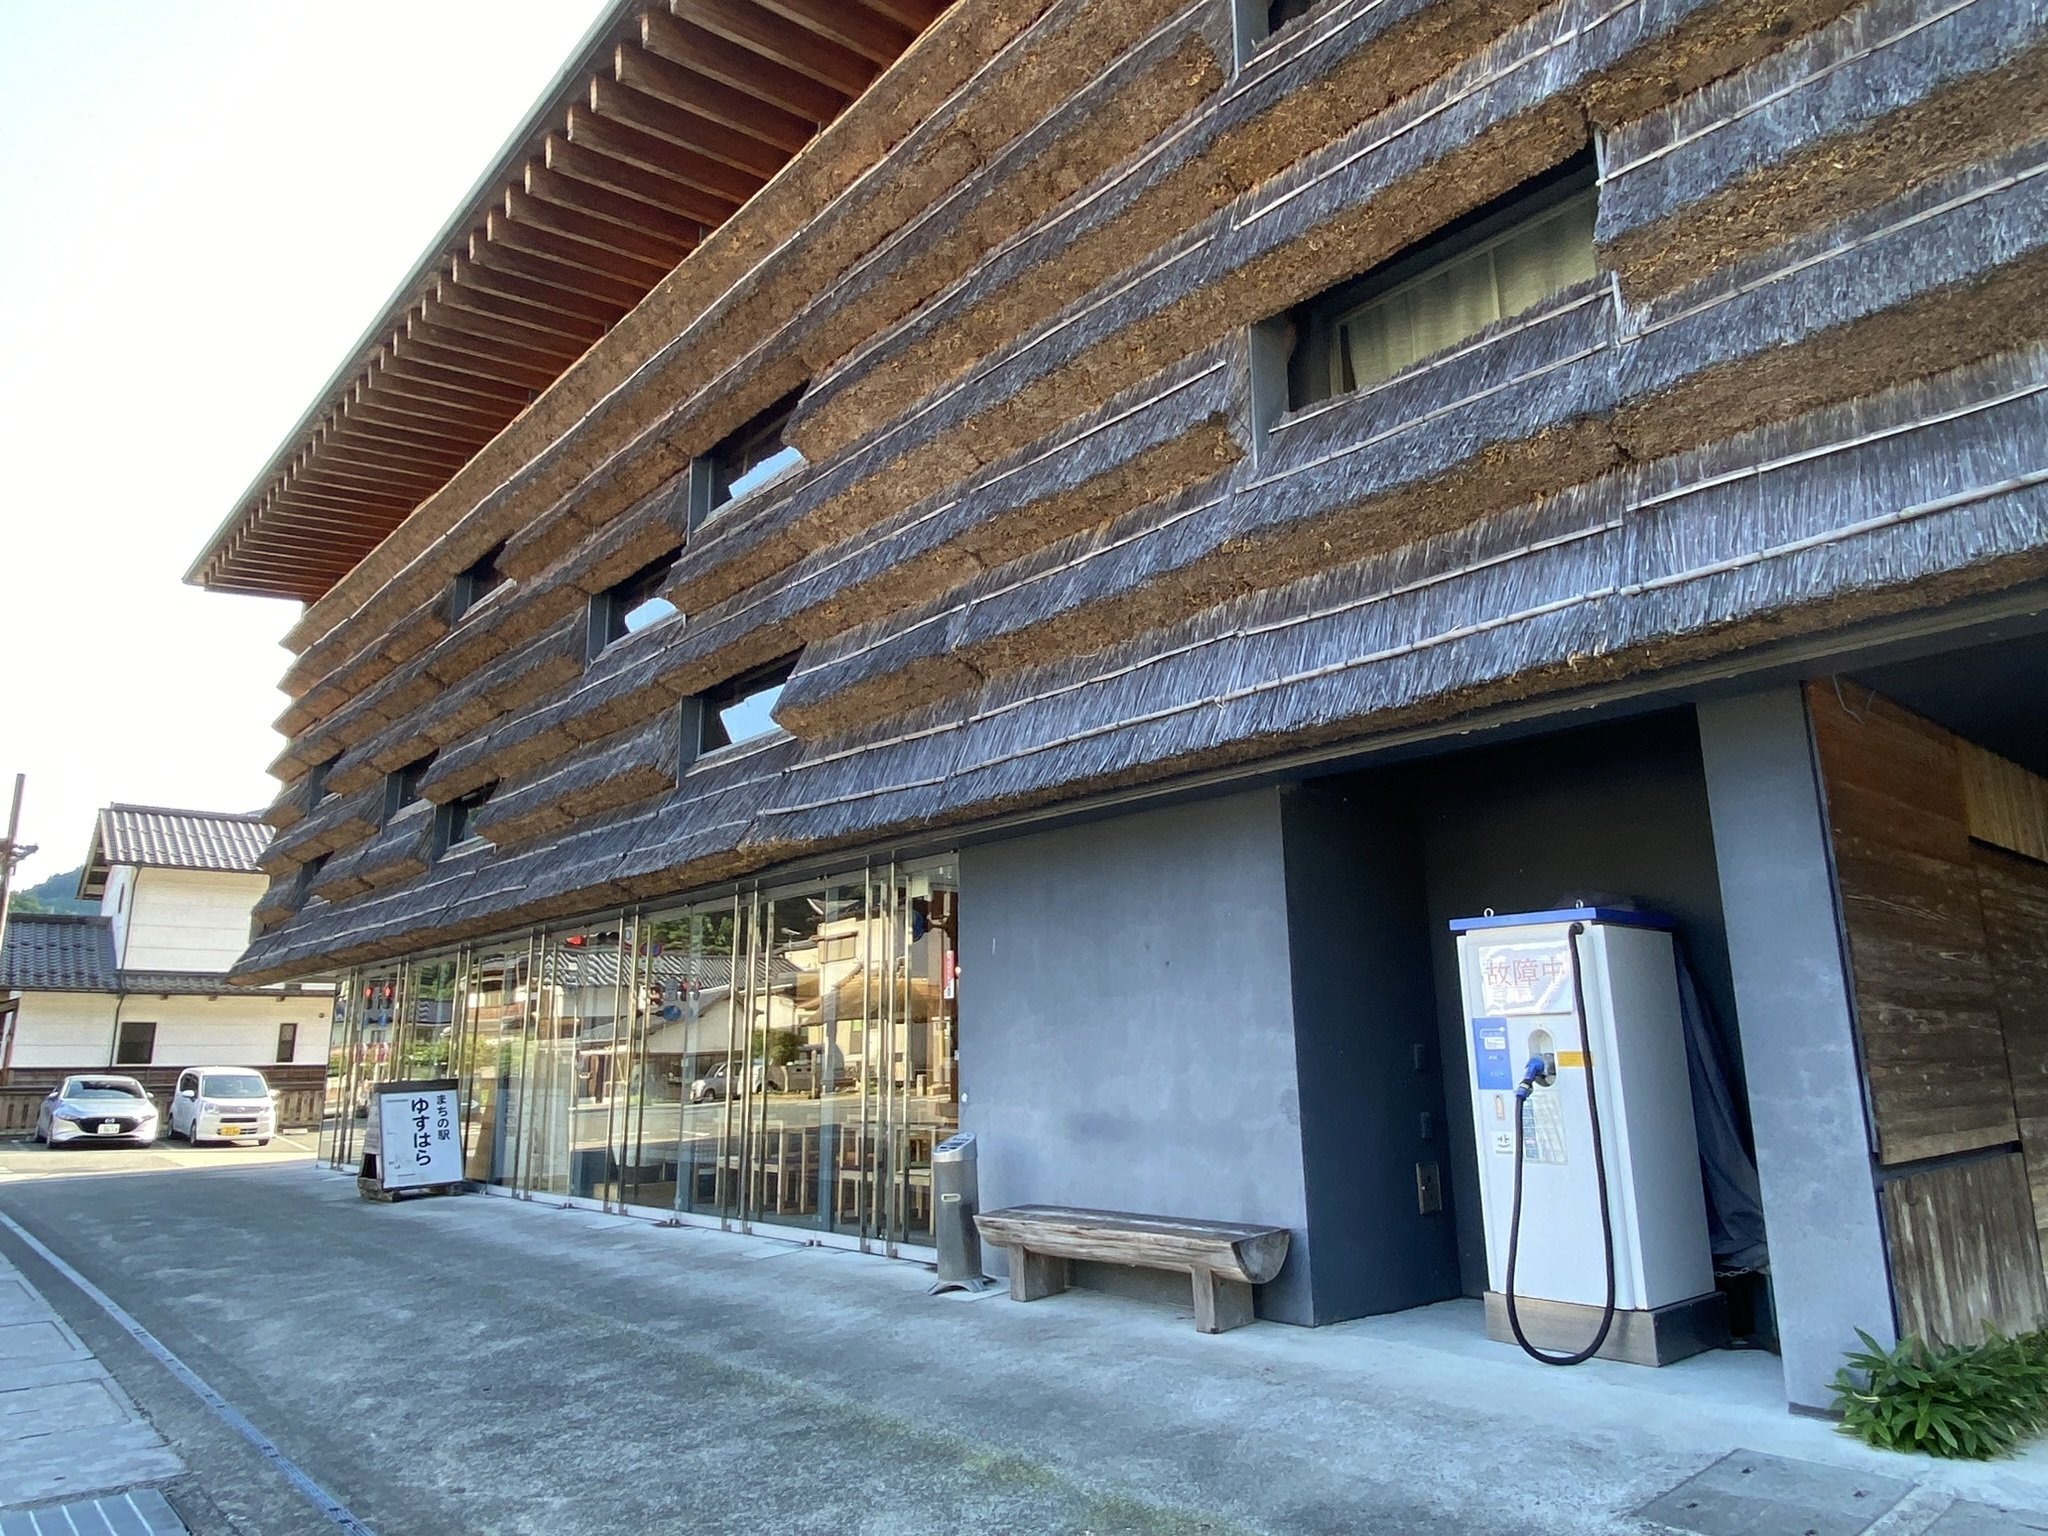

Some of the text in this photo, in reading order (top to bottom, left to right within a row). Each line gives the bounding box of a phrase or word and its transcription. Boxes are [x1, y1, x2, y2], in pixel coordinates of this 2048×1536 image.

[1486, 956, 1565, 986] 故障中
[411, 1097, 432, 1167] ゆすはら
[436, 1094, 451, 1140] まちの駅
